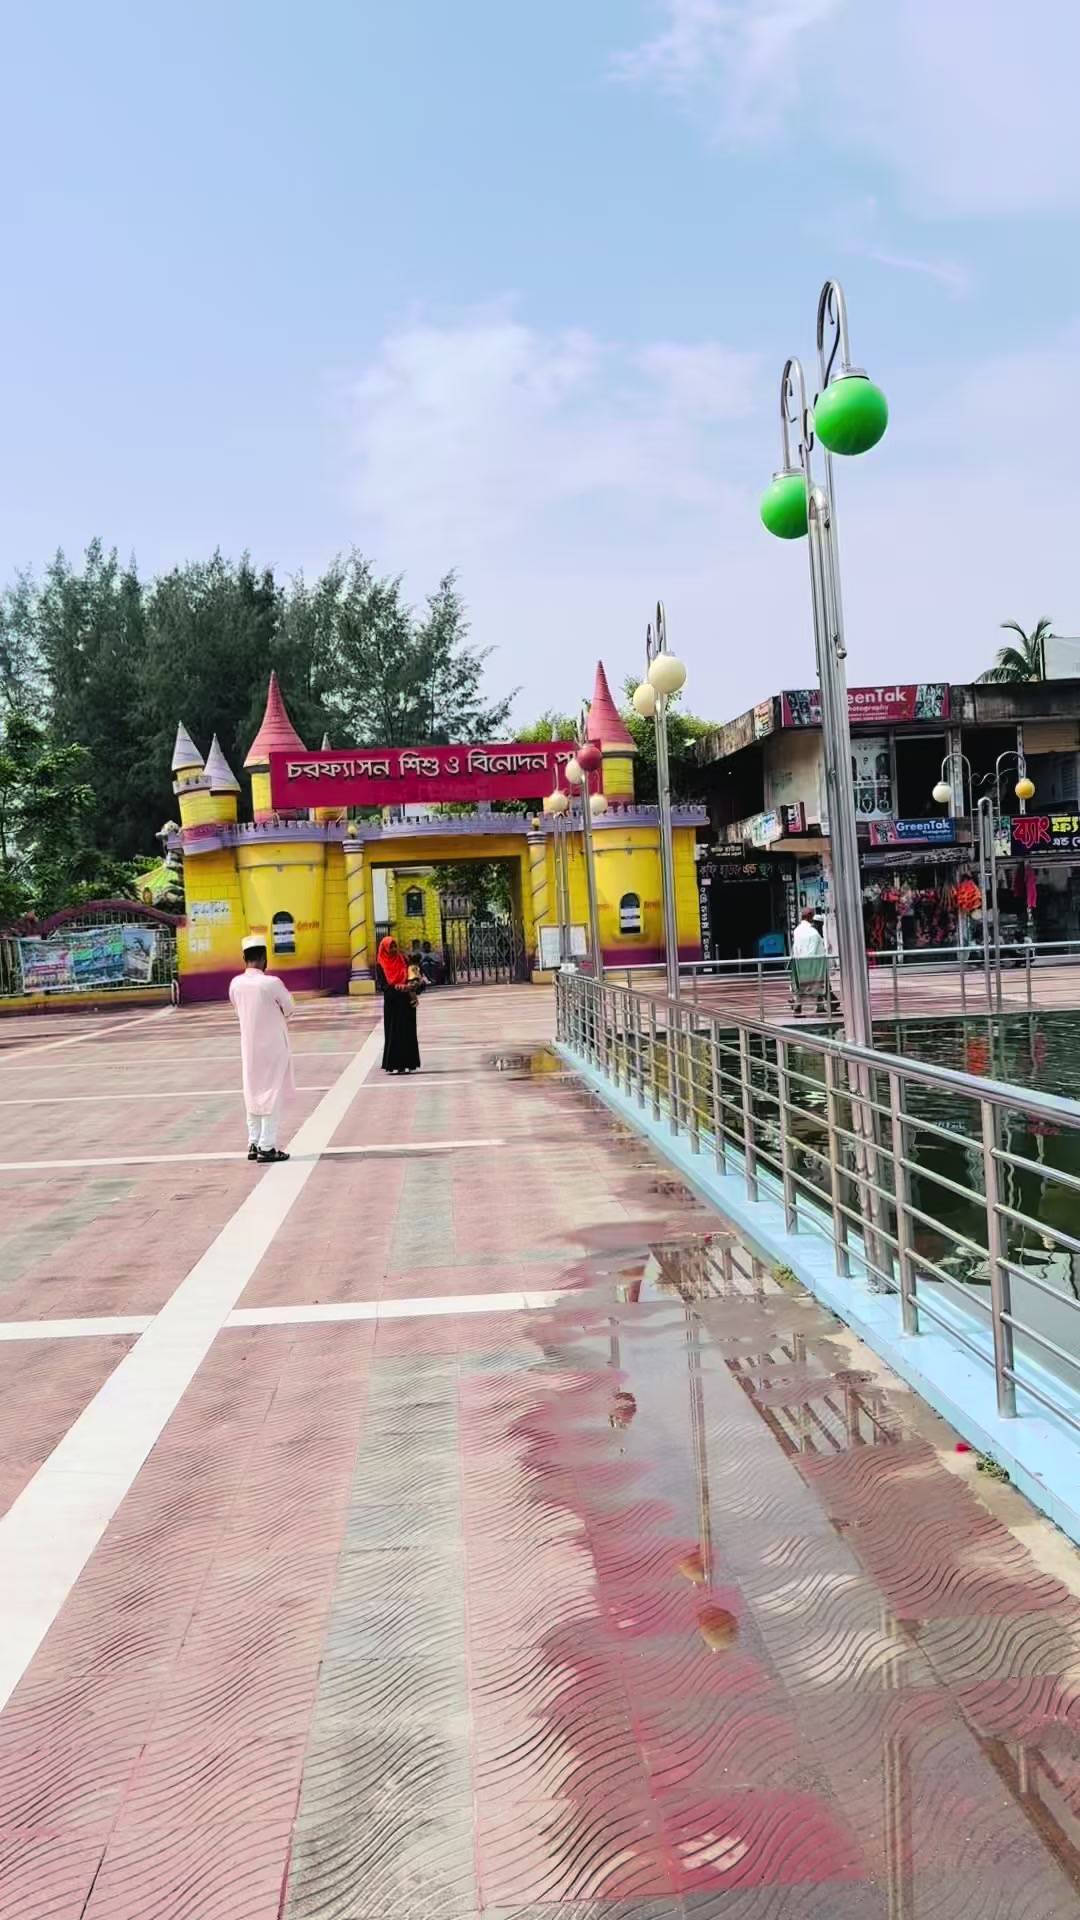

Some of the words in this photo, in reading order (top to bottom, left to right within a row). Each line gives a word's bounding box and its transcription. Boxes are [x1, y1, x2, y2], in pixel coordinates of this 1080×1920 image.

[847, 687, 907, 704] eenTak
[286, 759, 391, 780] চরফ্যাসন
[399, 751, 440, 778] শিশু
[444, 758, 460, 775] ও
[466, 749, 548, 775] বিনোদন
[896, 818, 951, 832] GreenTak
